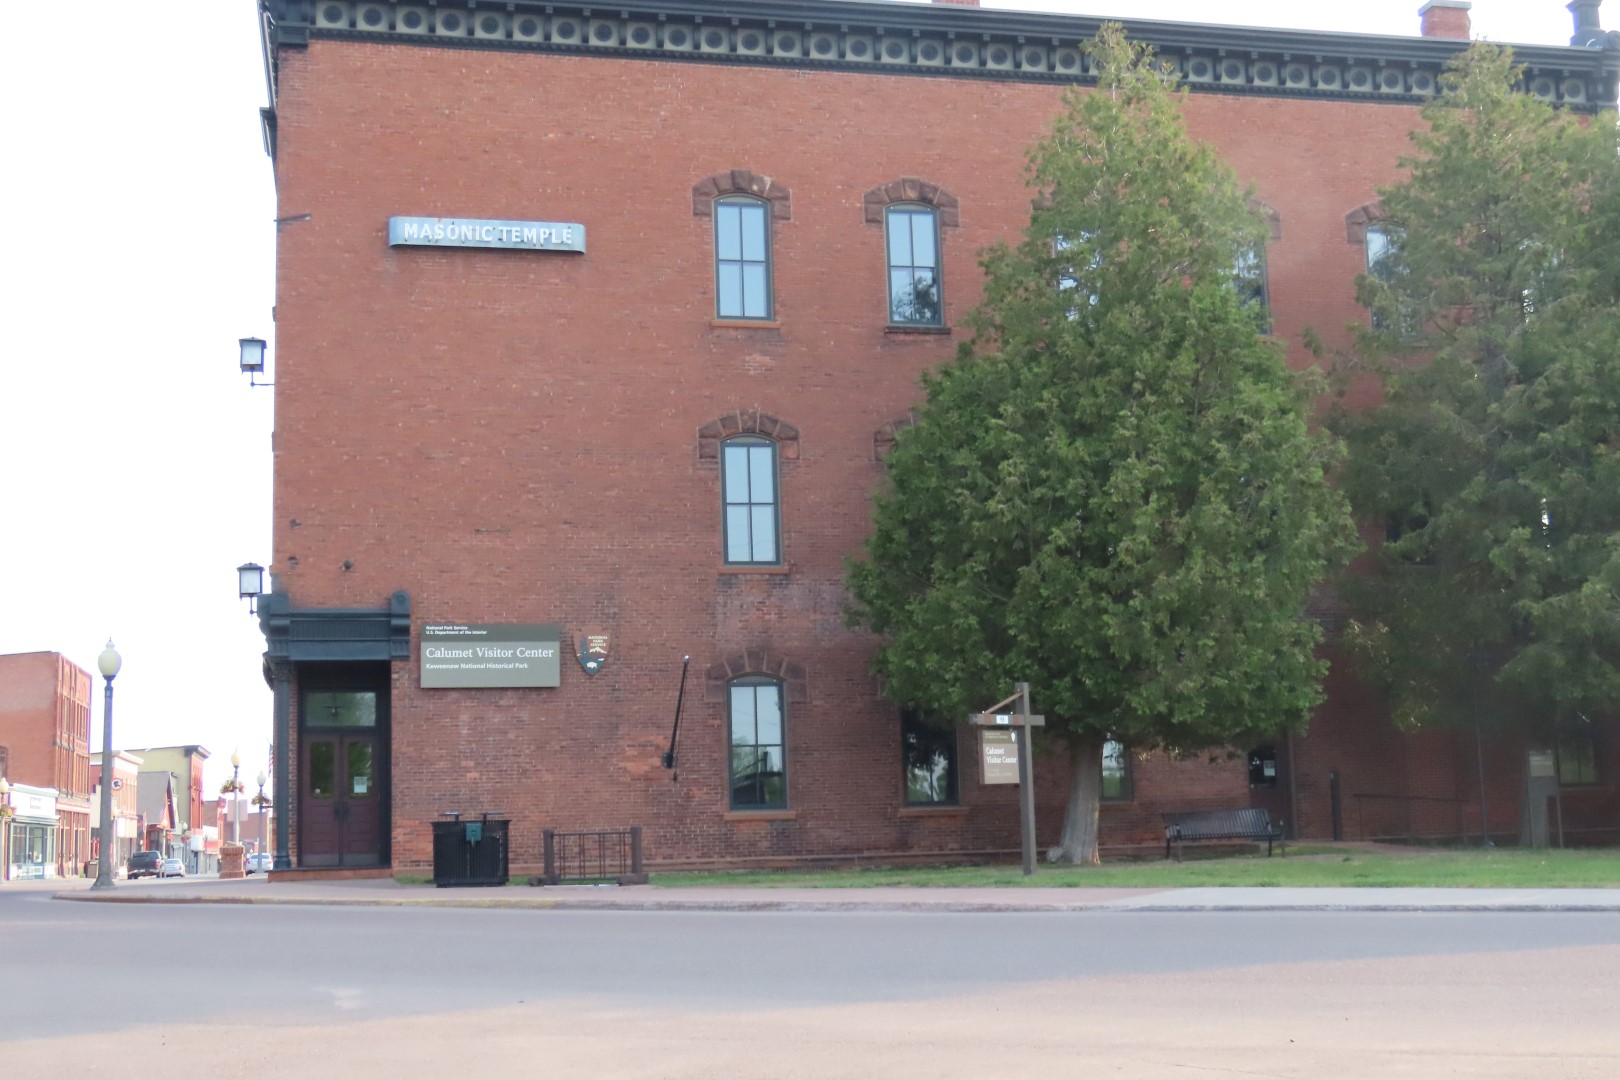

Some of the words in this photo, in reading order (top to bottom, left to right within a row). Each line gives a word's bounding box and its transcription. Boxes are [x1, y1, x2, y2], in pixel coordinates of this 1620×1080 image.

[404, 222, 493, 242] MASONIC
[498, 226, 572, 244] TEMPLE
[425, 647, 473, 659] Calumet
[476, 647, 514, 659] Visitor
[516, 647, 554, 658] Center
[985, 747, 1005, 755] Calumet
[986, 756, 1002, 764] Visitor
[1002, 756, 1017, 764] Center
